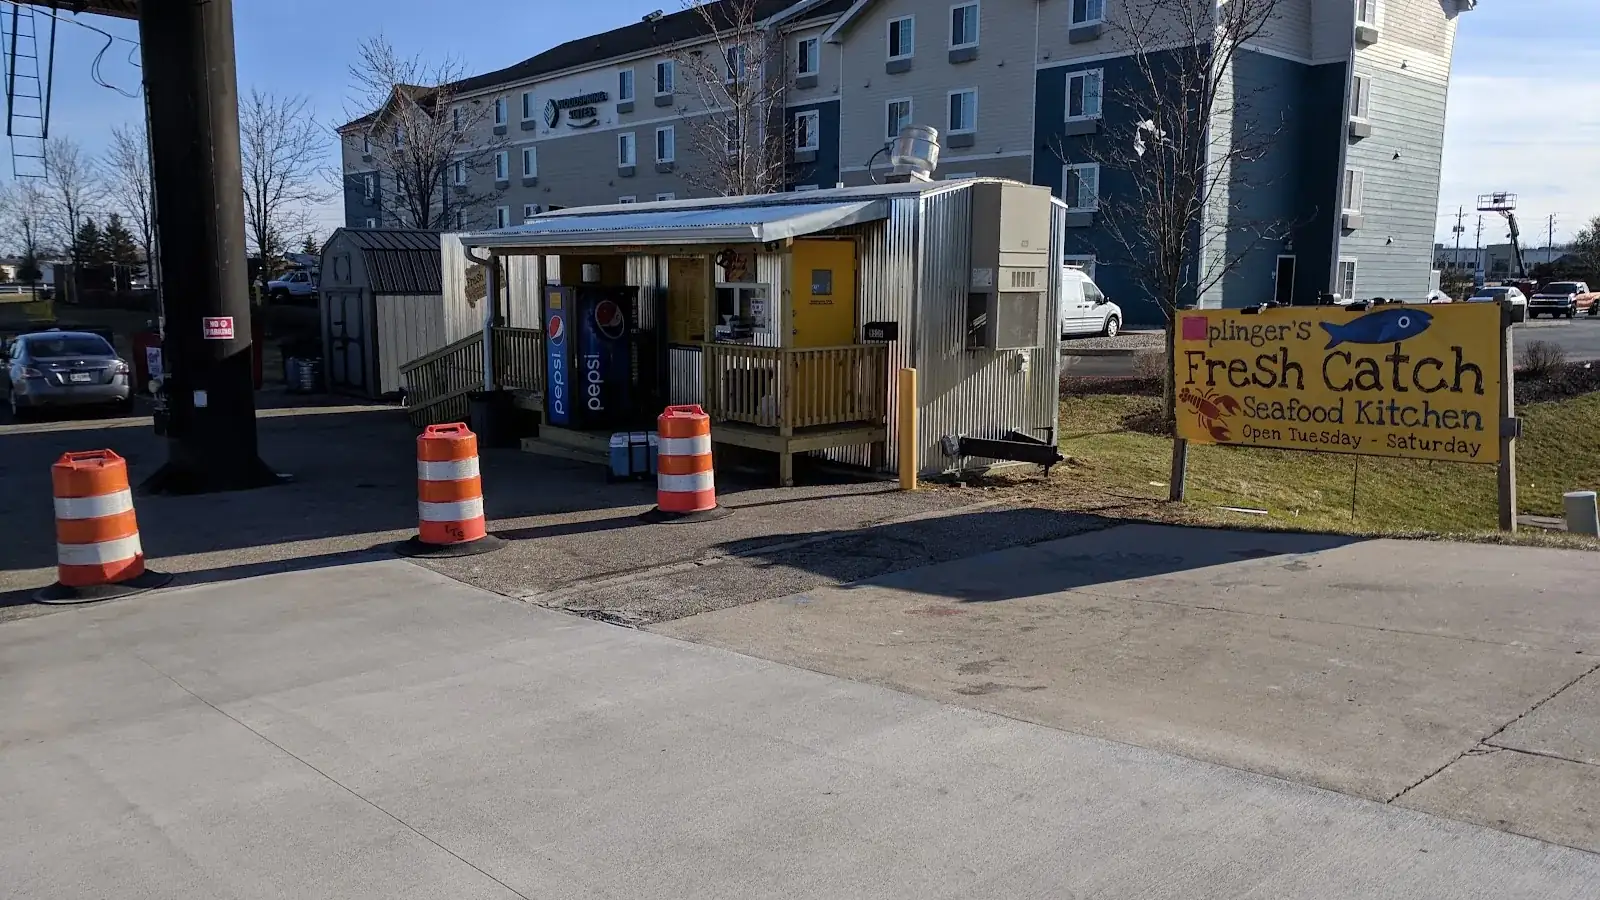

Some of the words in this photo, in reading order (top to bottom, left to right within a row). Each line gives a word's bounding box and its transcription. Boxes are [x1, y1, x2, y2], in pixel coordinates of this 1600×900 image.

[209, 320, 219, 328] NO
[1209, 319, 1312, 347] plinger's
[551, 350, 565, 415] pepsi
[584, 352, 604, 411] pepsi
[1184, 347, 1305, 391] Fresh
[1322, 342, 1485, 396] Catch
[1243, 396, 1345, 424] Seafood
[1355, 398, 1484, 432] Kitchen
[1242, 424, 1281, 442] Open
[1288, 427, 1362, 450] Tuesday
[1386, 432, 1482, 458] Saturday
